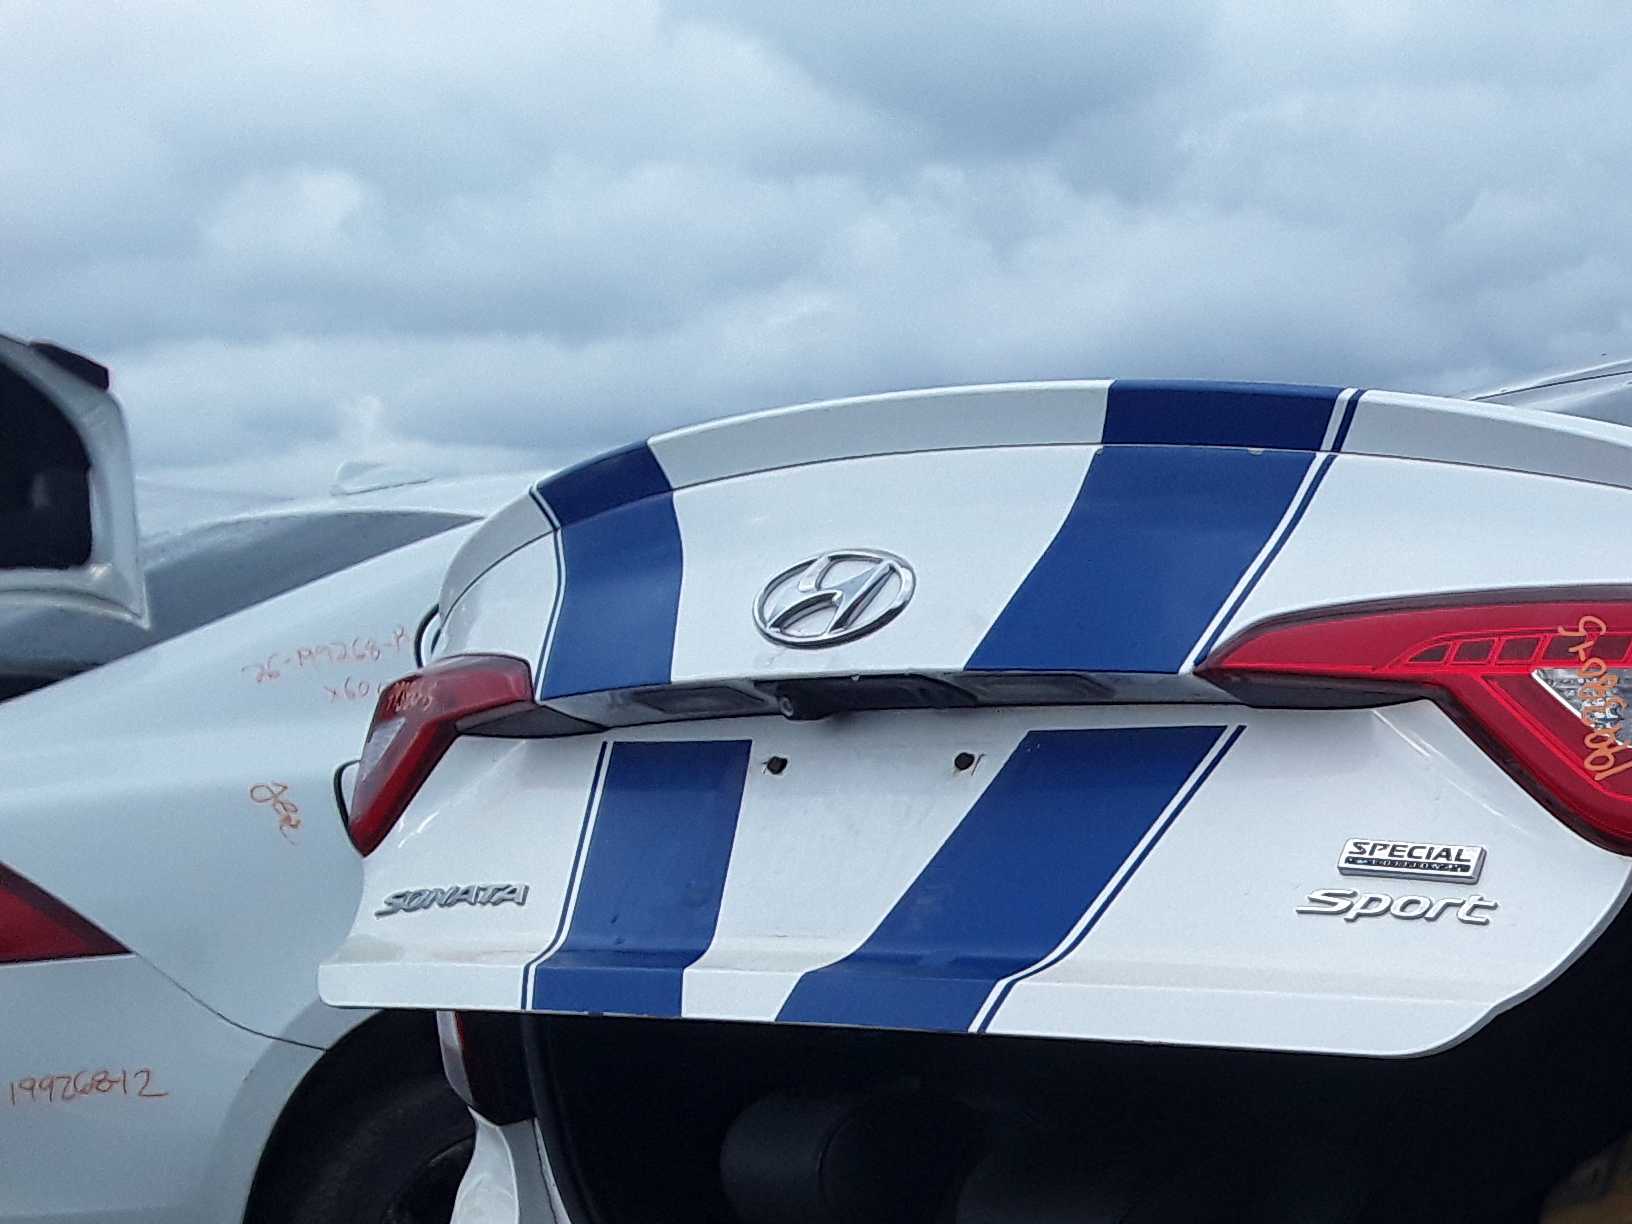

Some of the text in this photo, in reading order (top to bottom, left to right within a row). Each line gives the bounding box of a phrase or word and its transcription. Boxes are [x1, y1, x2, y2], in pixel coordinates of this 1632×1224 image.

[1347, 840, 1473, 863] SPECIAL
[374, 883, 530, 919] SONATA
[1296, 887, 1498, 925] Sport
